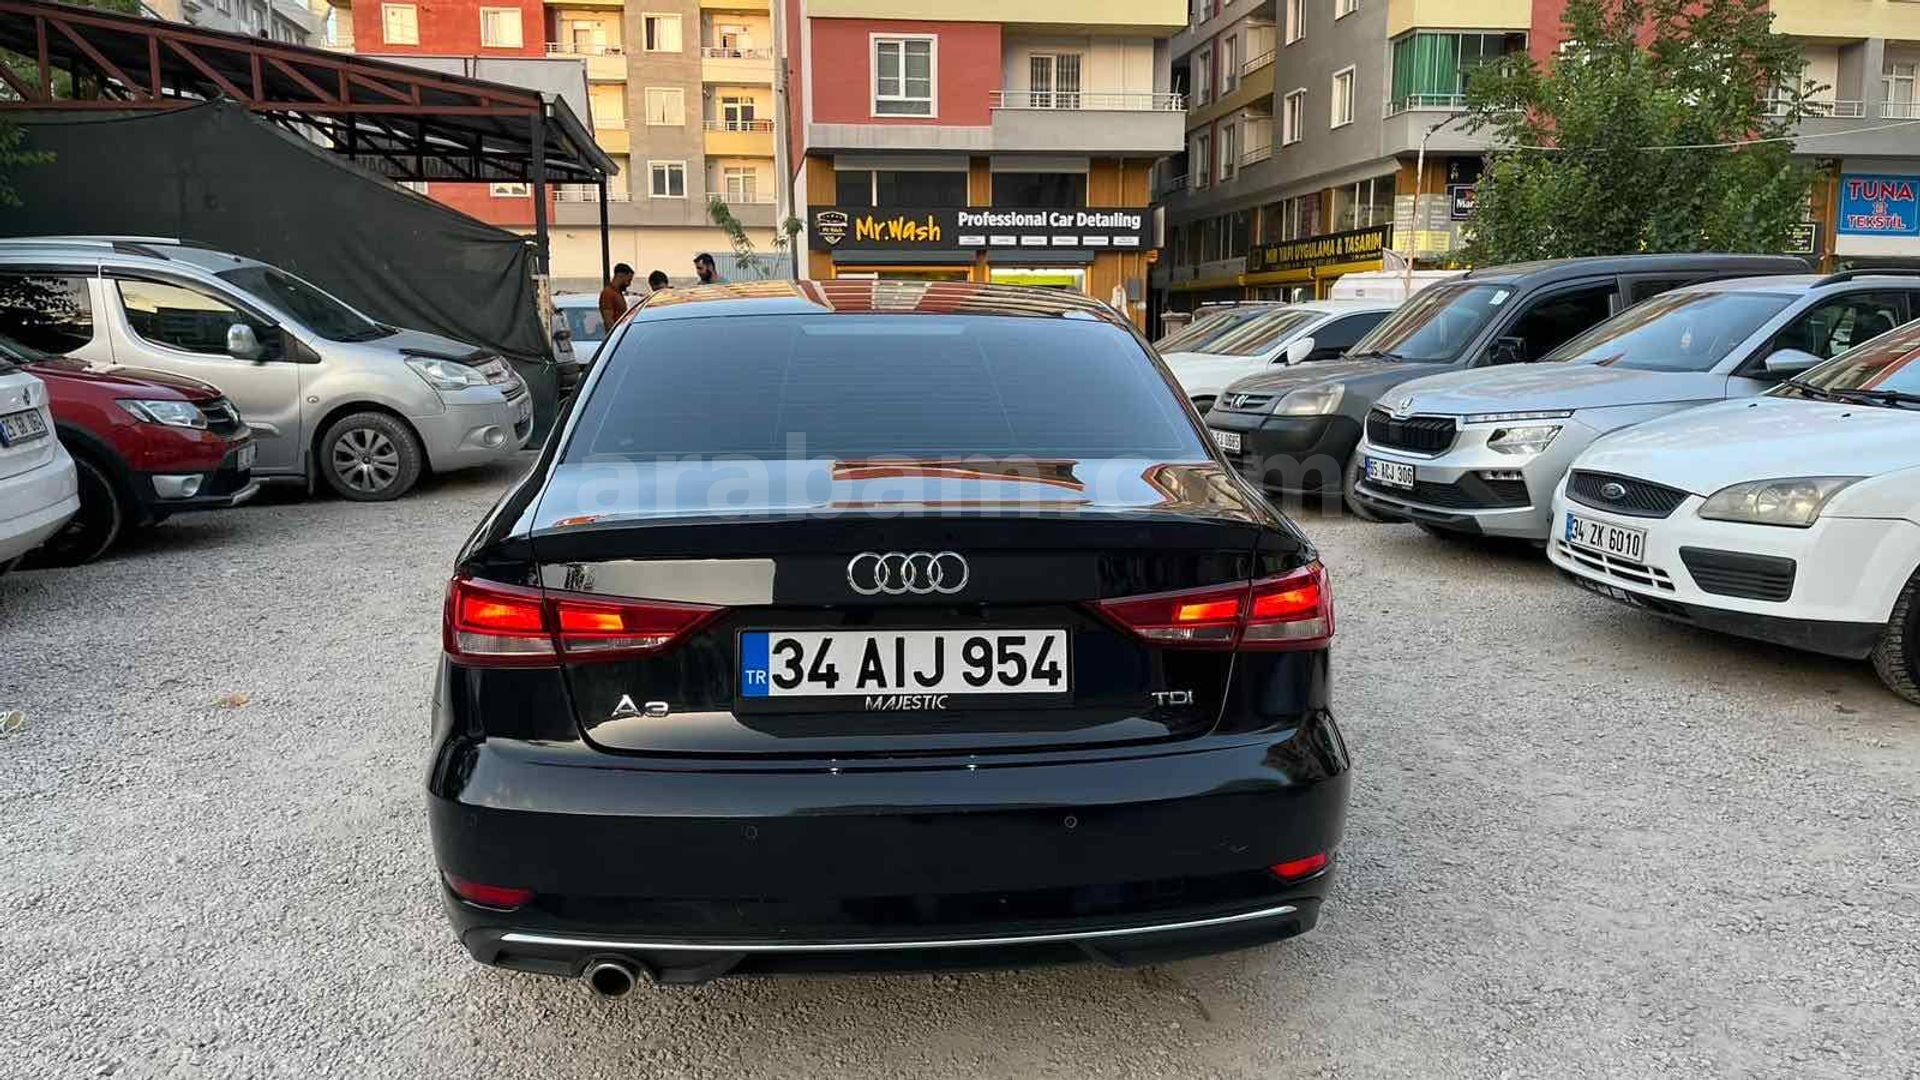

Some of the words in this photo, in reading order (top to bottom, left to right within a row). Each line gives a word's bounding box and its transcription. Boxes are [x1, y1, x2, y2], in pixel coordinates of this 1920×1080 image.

[1849, 180, 1915, 201] TUNA
[958, 211, 1047, 227] Professional
[1050, 212, 1077, 227] Car
[1077, 212, 1141, 229] Detailing
[1345, 232, 1383, 253] TASARIM
[1397, 465, 1413, 484] 306
[1571, 518, 1584, 541] 34
[1609, 528, 1640, 556] 6010
[771, 637, 840, 689] 34
[856, 637, 944, 689] AIJ
[961, 636, 1062, 687] 954
[745, 670, 767, 685] TR
[865, 694, 949, 711] MAJESTIC
[1151, 690, 1194, 706] TDI
